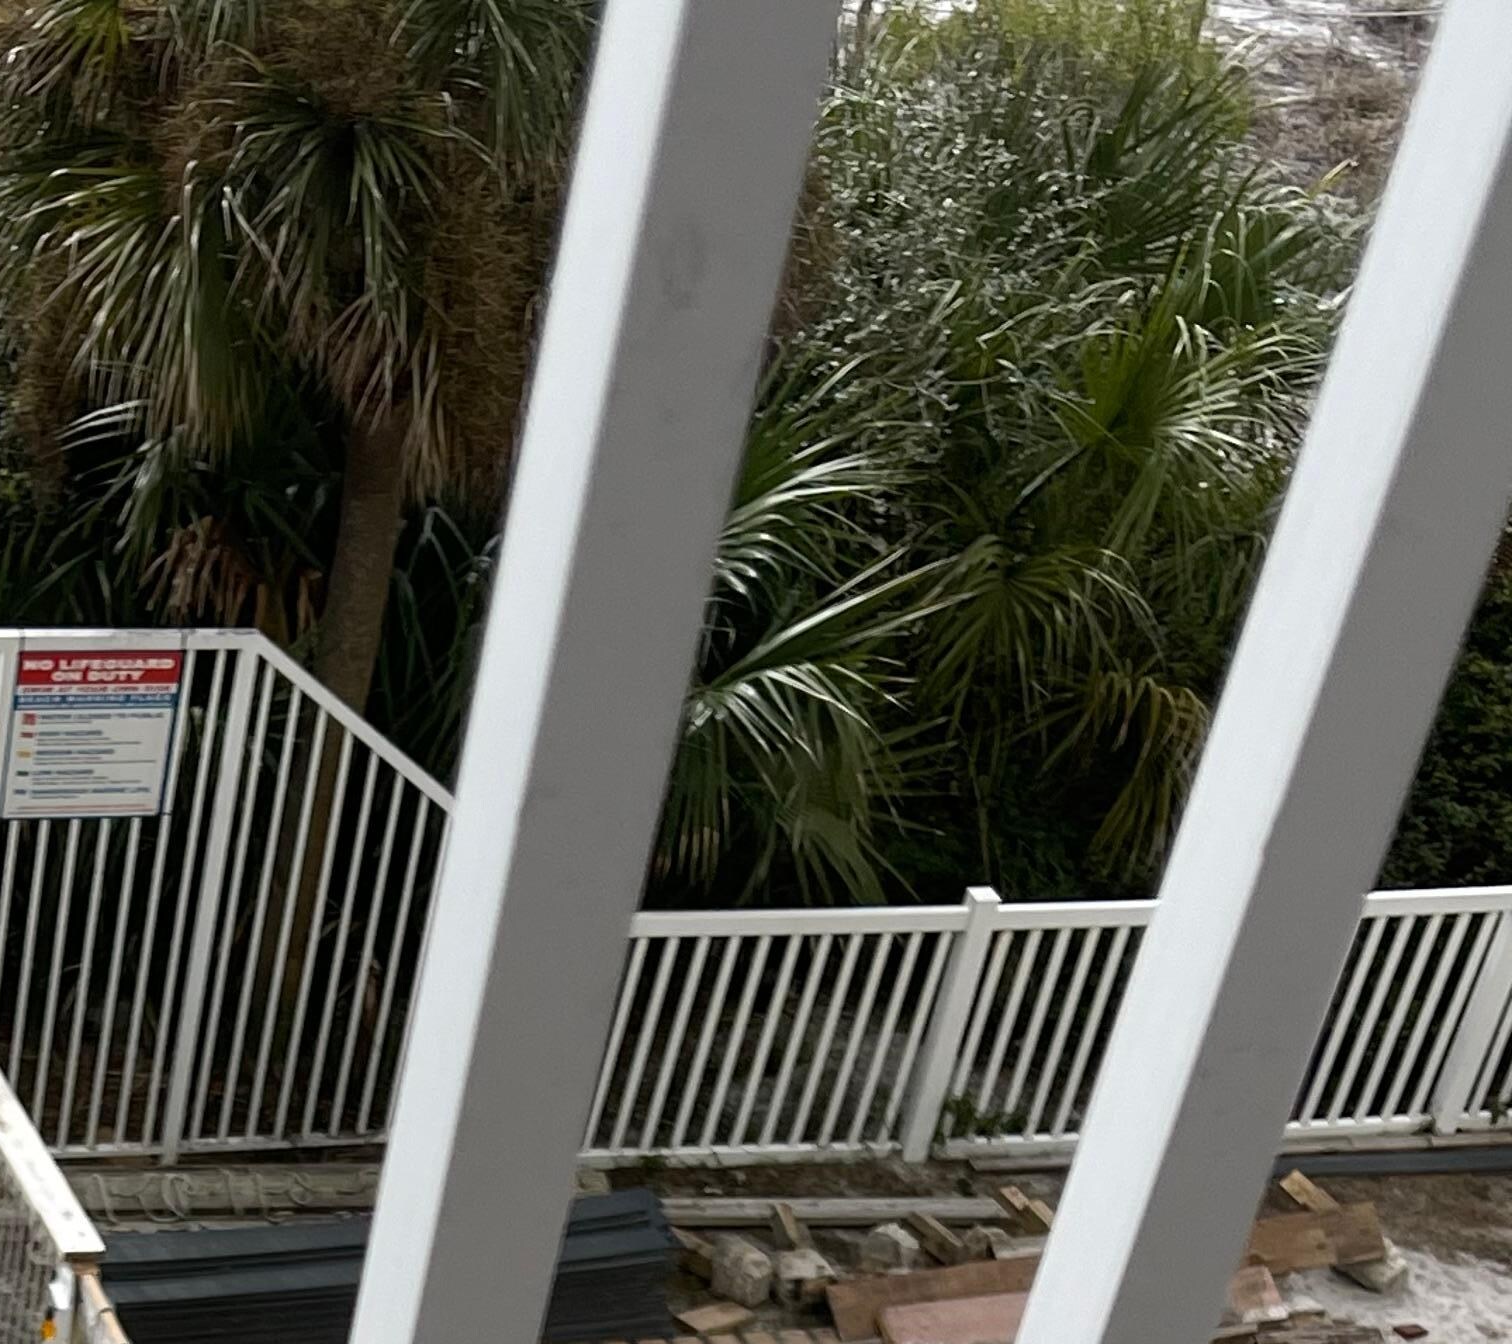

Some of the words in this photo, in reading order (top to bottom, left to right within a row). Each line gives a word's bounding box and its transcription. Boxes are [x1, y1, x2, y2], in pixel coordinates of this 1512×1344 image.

[23, 660, 54, 671] NO
[59, 659, 176, 670] LIFEGUARD
[51, 671, 82, 681] ON
[87, 670, 145, 681] DUTY
